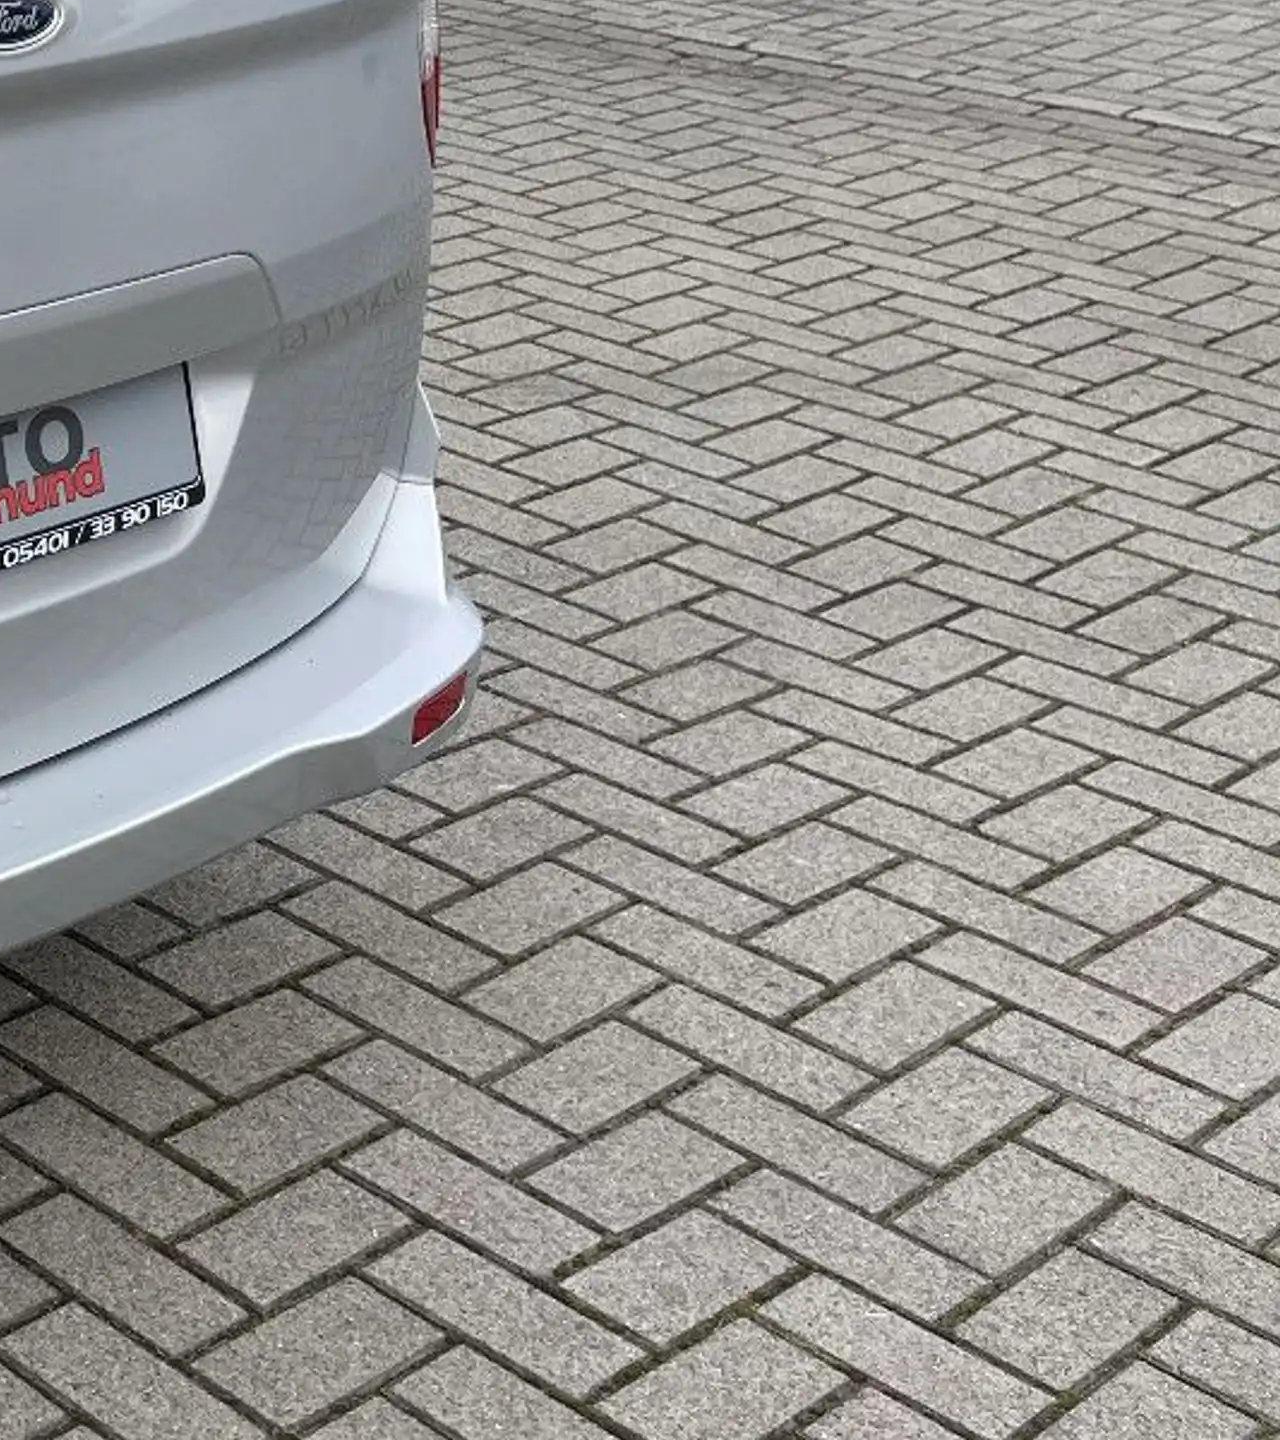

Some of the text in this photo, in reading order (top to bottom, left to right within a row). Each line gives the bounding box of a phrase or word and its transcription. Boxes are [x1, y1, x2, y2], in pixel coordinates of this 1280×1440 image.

[3, 529, 69, 569] 05401
[90, 515, 116, 539] 33
[120, 504, 150, 529] 90
[156, 490, 189, 517] 150
